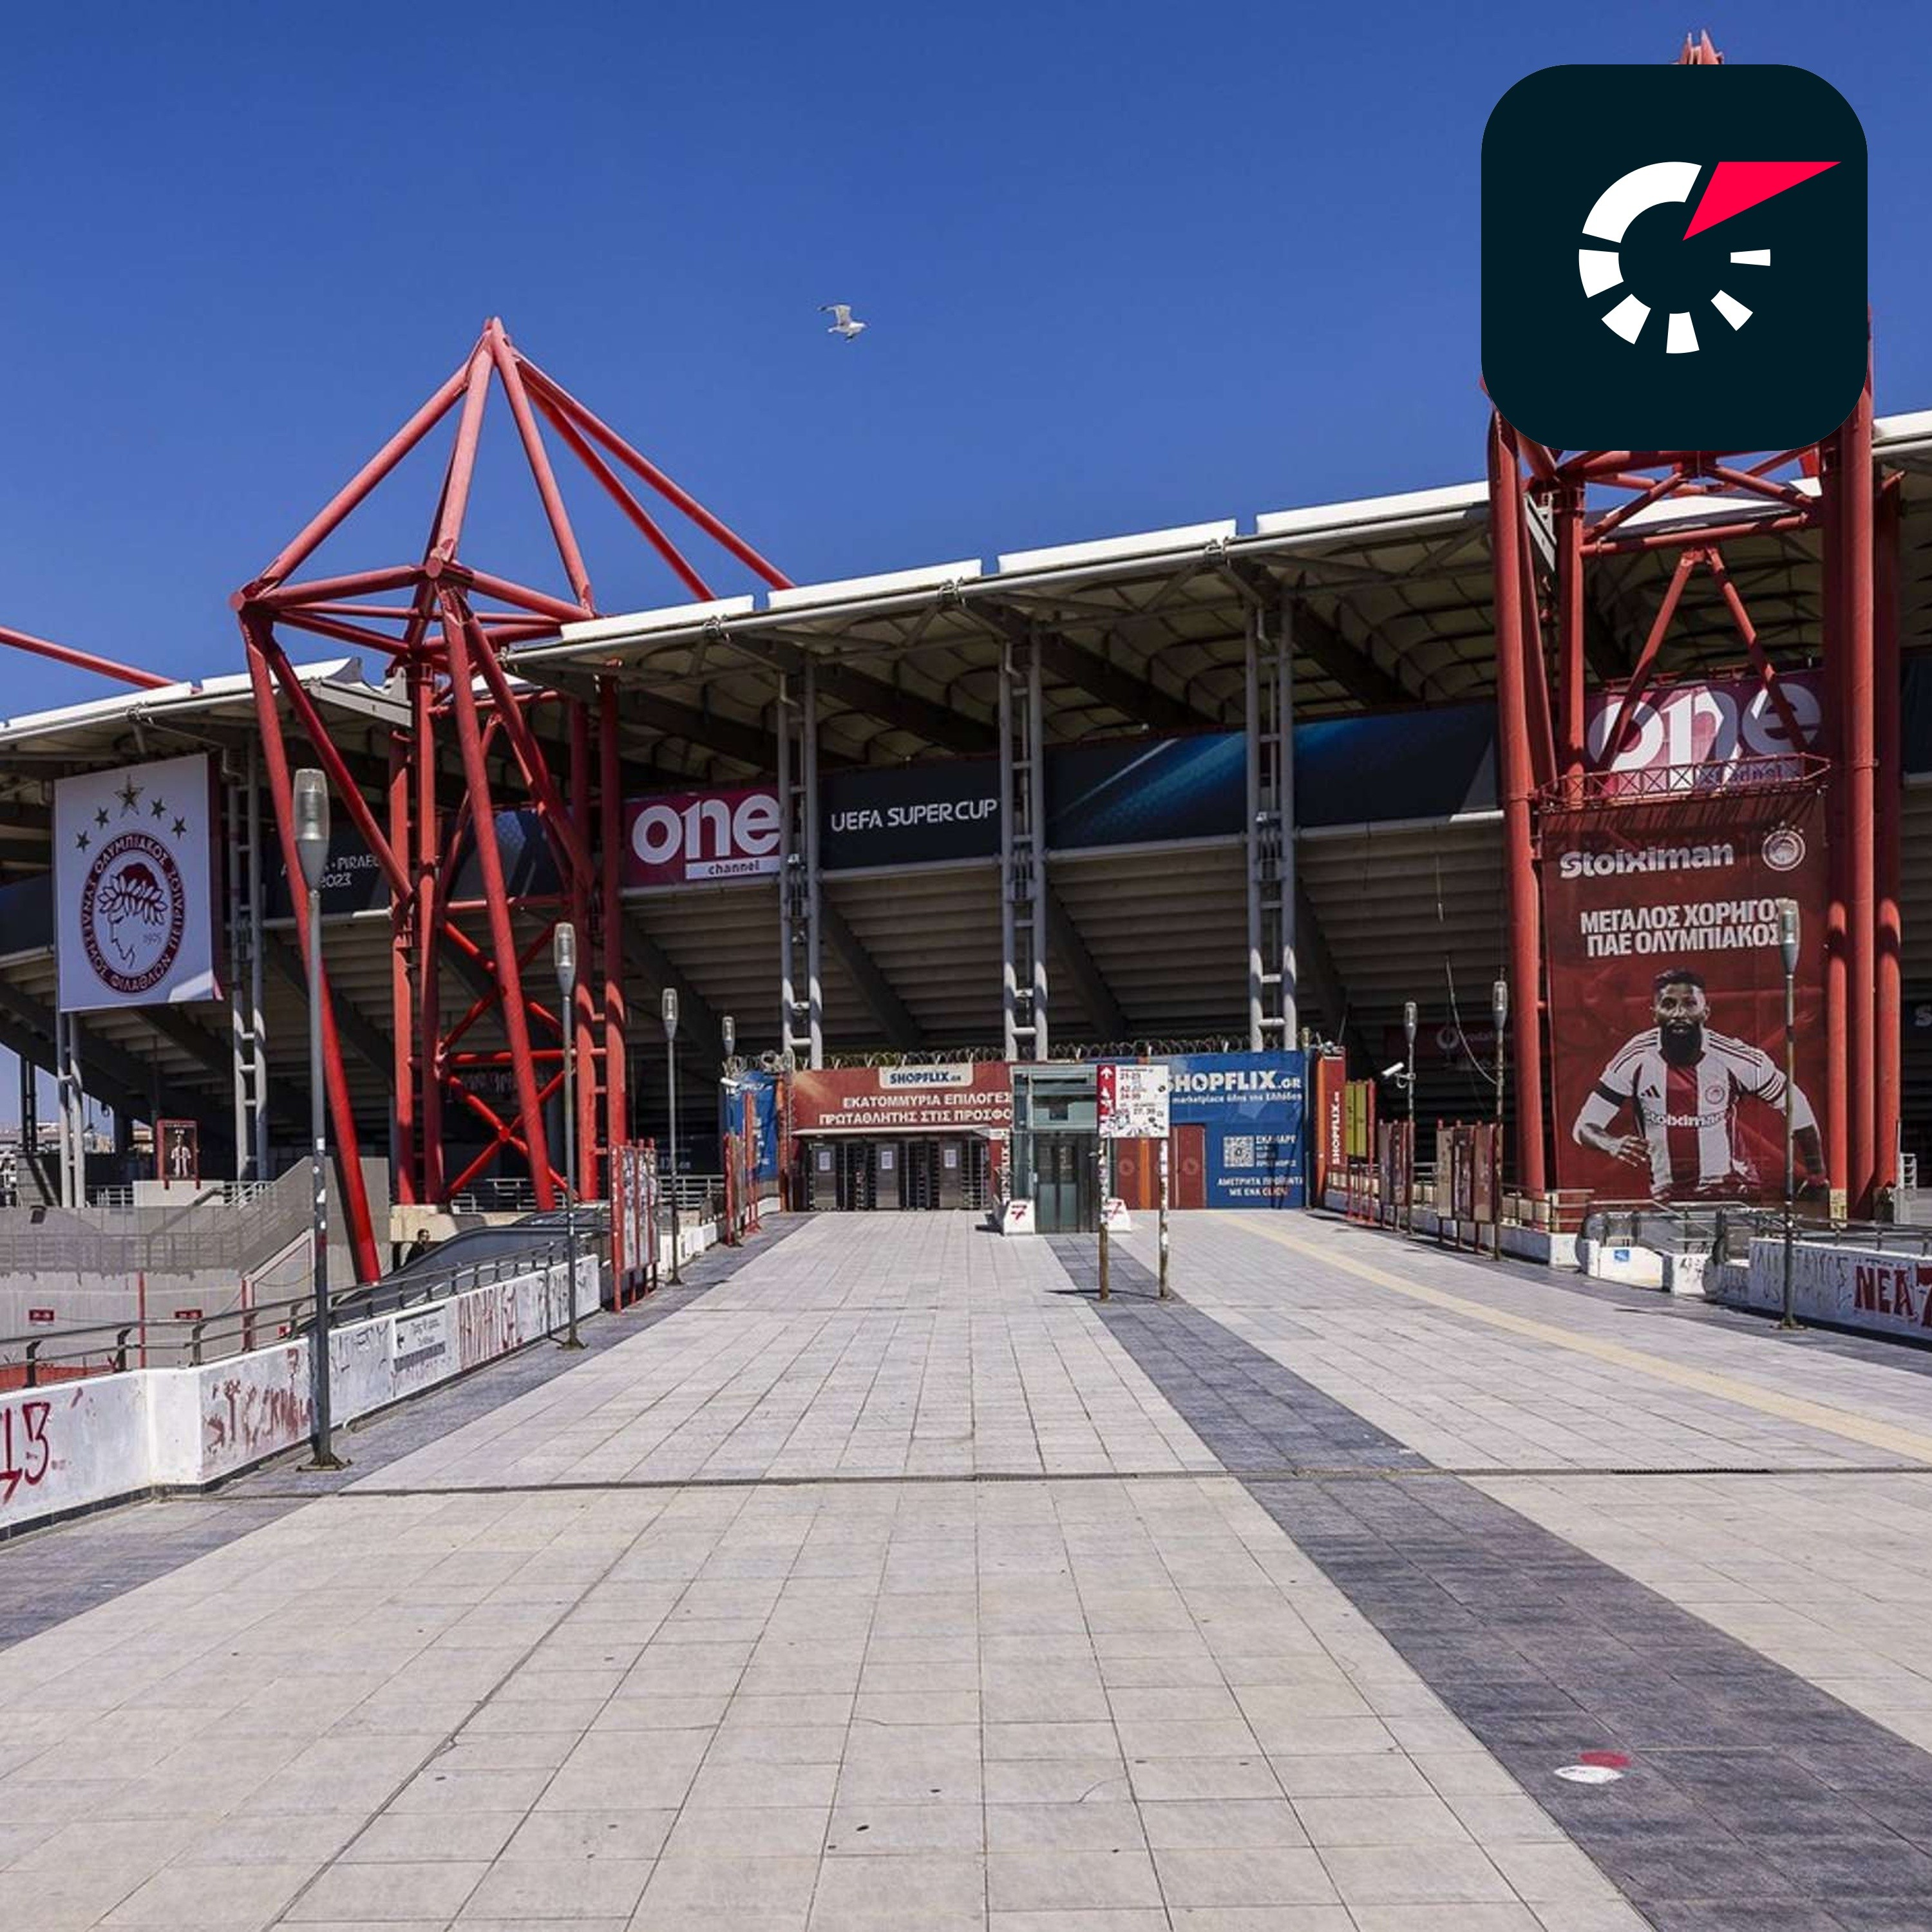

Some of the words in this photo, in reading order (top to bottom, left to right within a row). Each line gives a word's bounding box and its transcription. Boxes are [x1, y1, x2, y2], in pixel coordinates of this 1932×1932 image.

[632, 794, 781, 864] one
[831, 810, 883, 832] UEFA
[887, 802, 954, 827] SUPER
[955, 799, 998, 820] CUP
[708, 860, 761, 875] channel
[1560, 842, 1734, 878] Stoiximan
[1580, 904, 1680, 934] ΜΕΓΑΛΟΣ
[1587, 934, 1632, 958] ΠΑΕ
[1635, 923, 1780, 954] ΟΛΥΜΠΙΑΚΟΣ
[843, 1095, 942, 1108] ΕΚΑΤΟΜΜΥΡΙΑ
[819, 1110, 918, 1125] ΠΡΩΤΑΘΛΗΤΗΣ
[921, 1110, 952, 1122] ΣΤΙΣ
